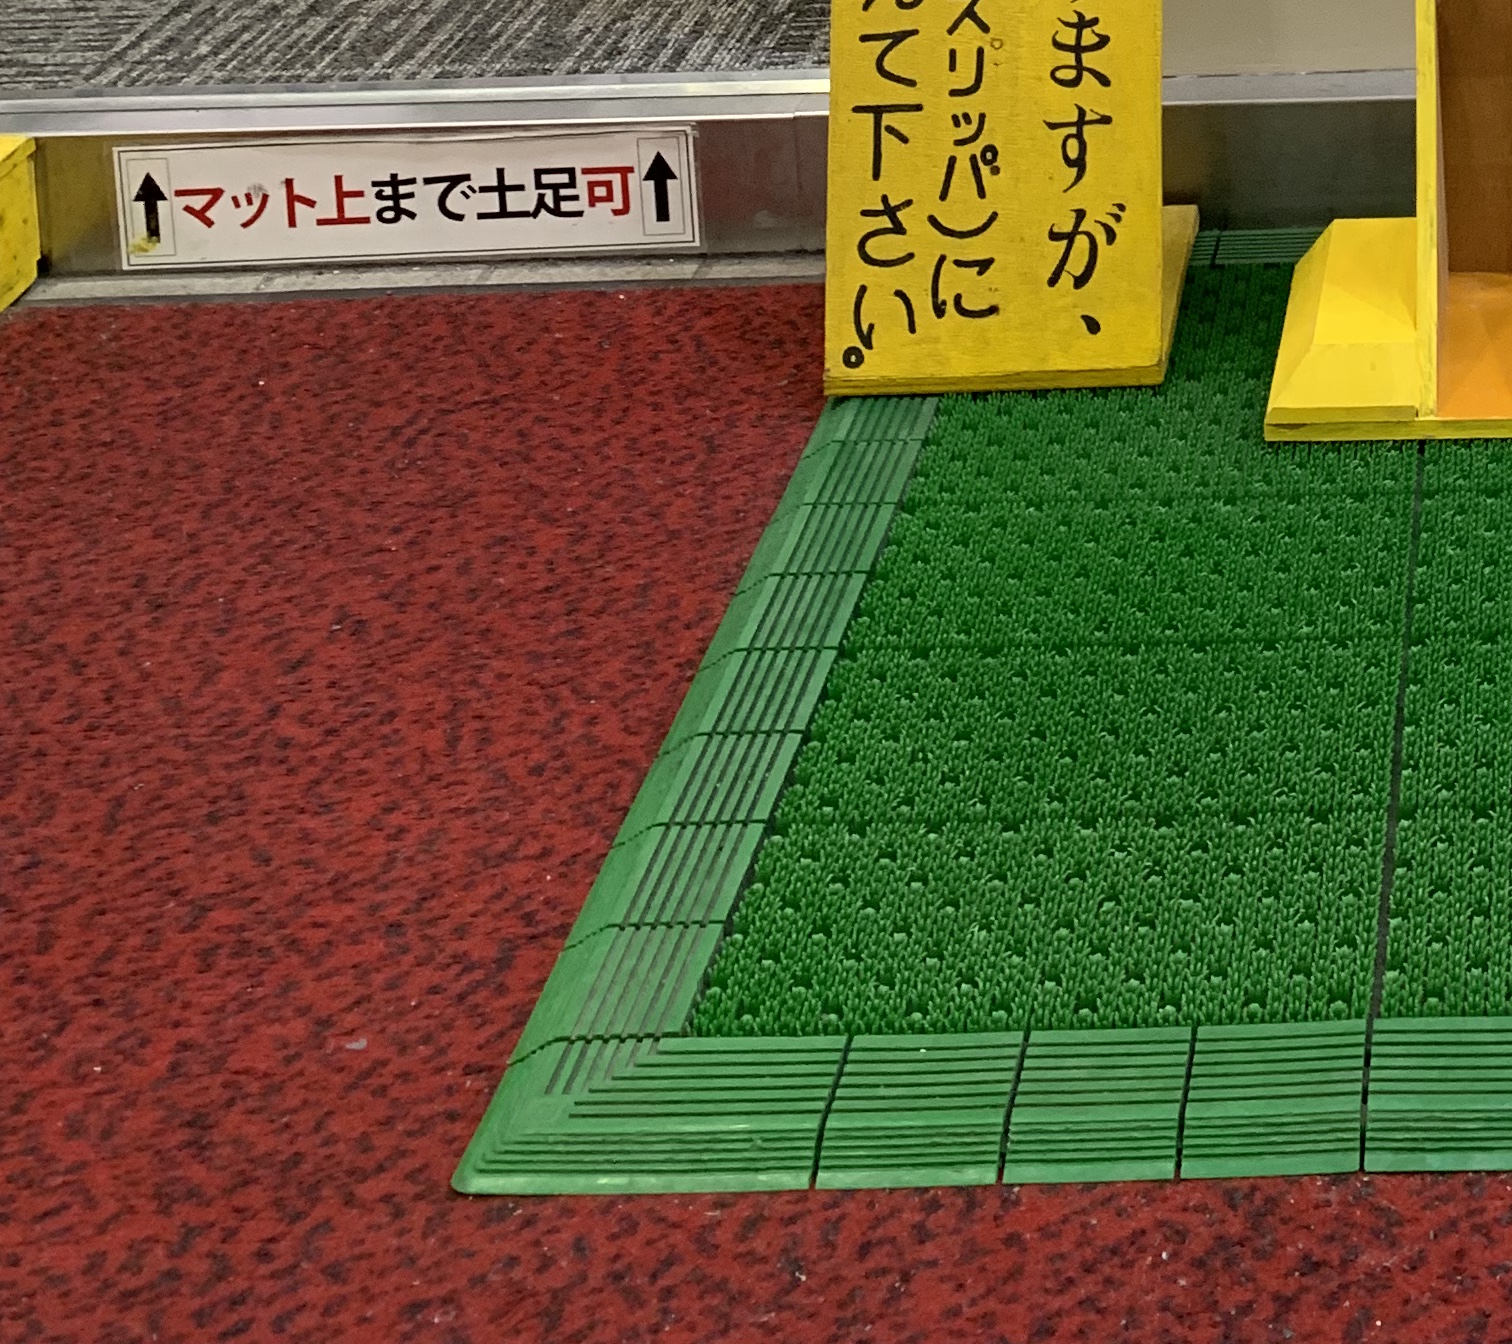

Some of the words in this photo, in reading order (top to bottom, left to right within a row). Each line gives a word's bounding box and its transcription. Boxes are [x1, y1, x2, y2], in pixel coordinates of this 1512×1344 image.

[174, 166, 635, 229] マット上まで土足可
